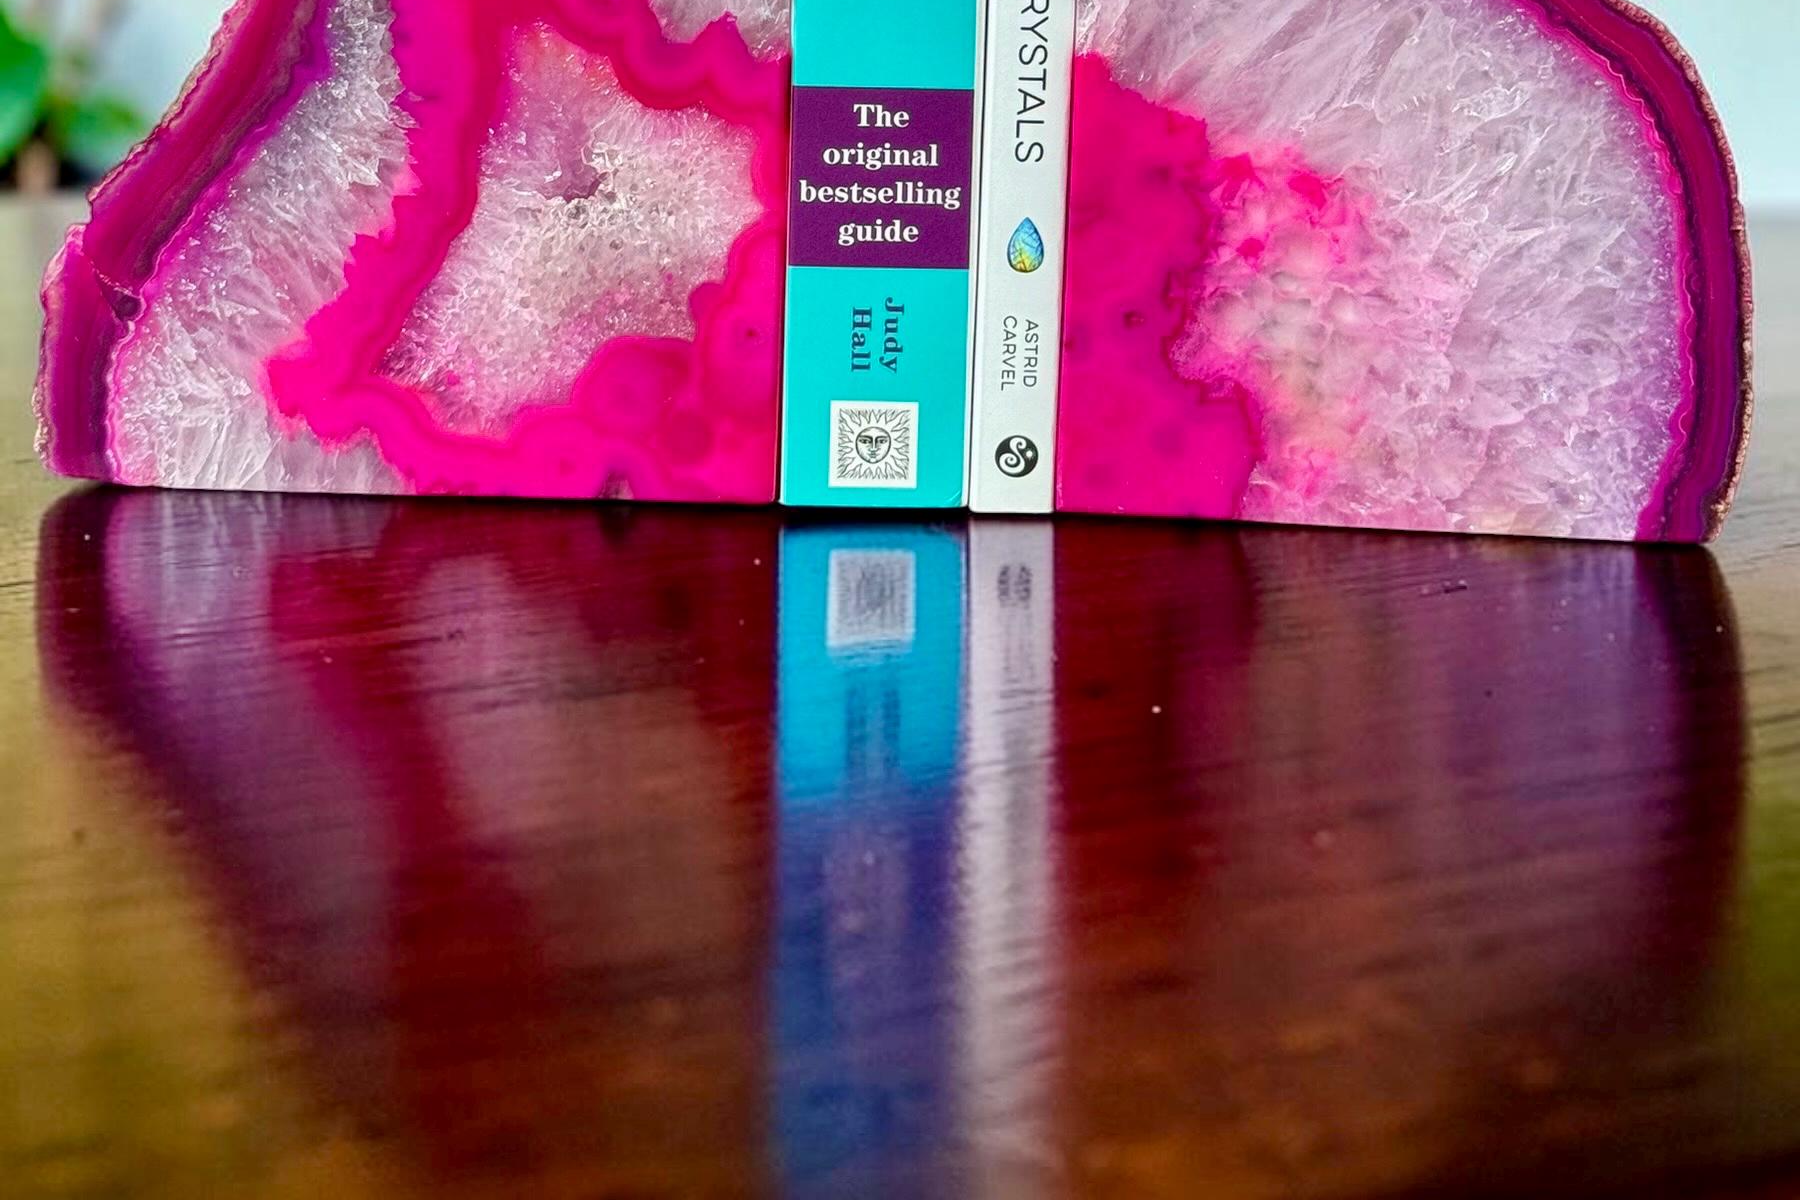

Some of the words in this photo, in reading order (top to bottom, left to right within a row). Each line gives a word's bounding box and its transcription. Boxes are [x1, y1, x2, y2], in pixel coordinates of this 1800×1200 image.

[853, 103, 910, 128] The
[822, 142, 939, 170] original
[799, 179, 961, 210] bestselling
[837, 218, 920, 246] guide
[850, 306, 873, 373] Hall
[879, 297, 905, 374] Judy
[1000, 314, 1018, 391] CARVEL
[1023, 318, 1039, 389] ASTRID
